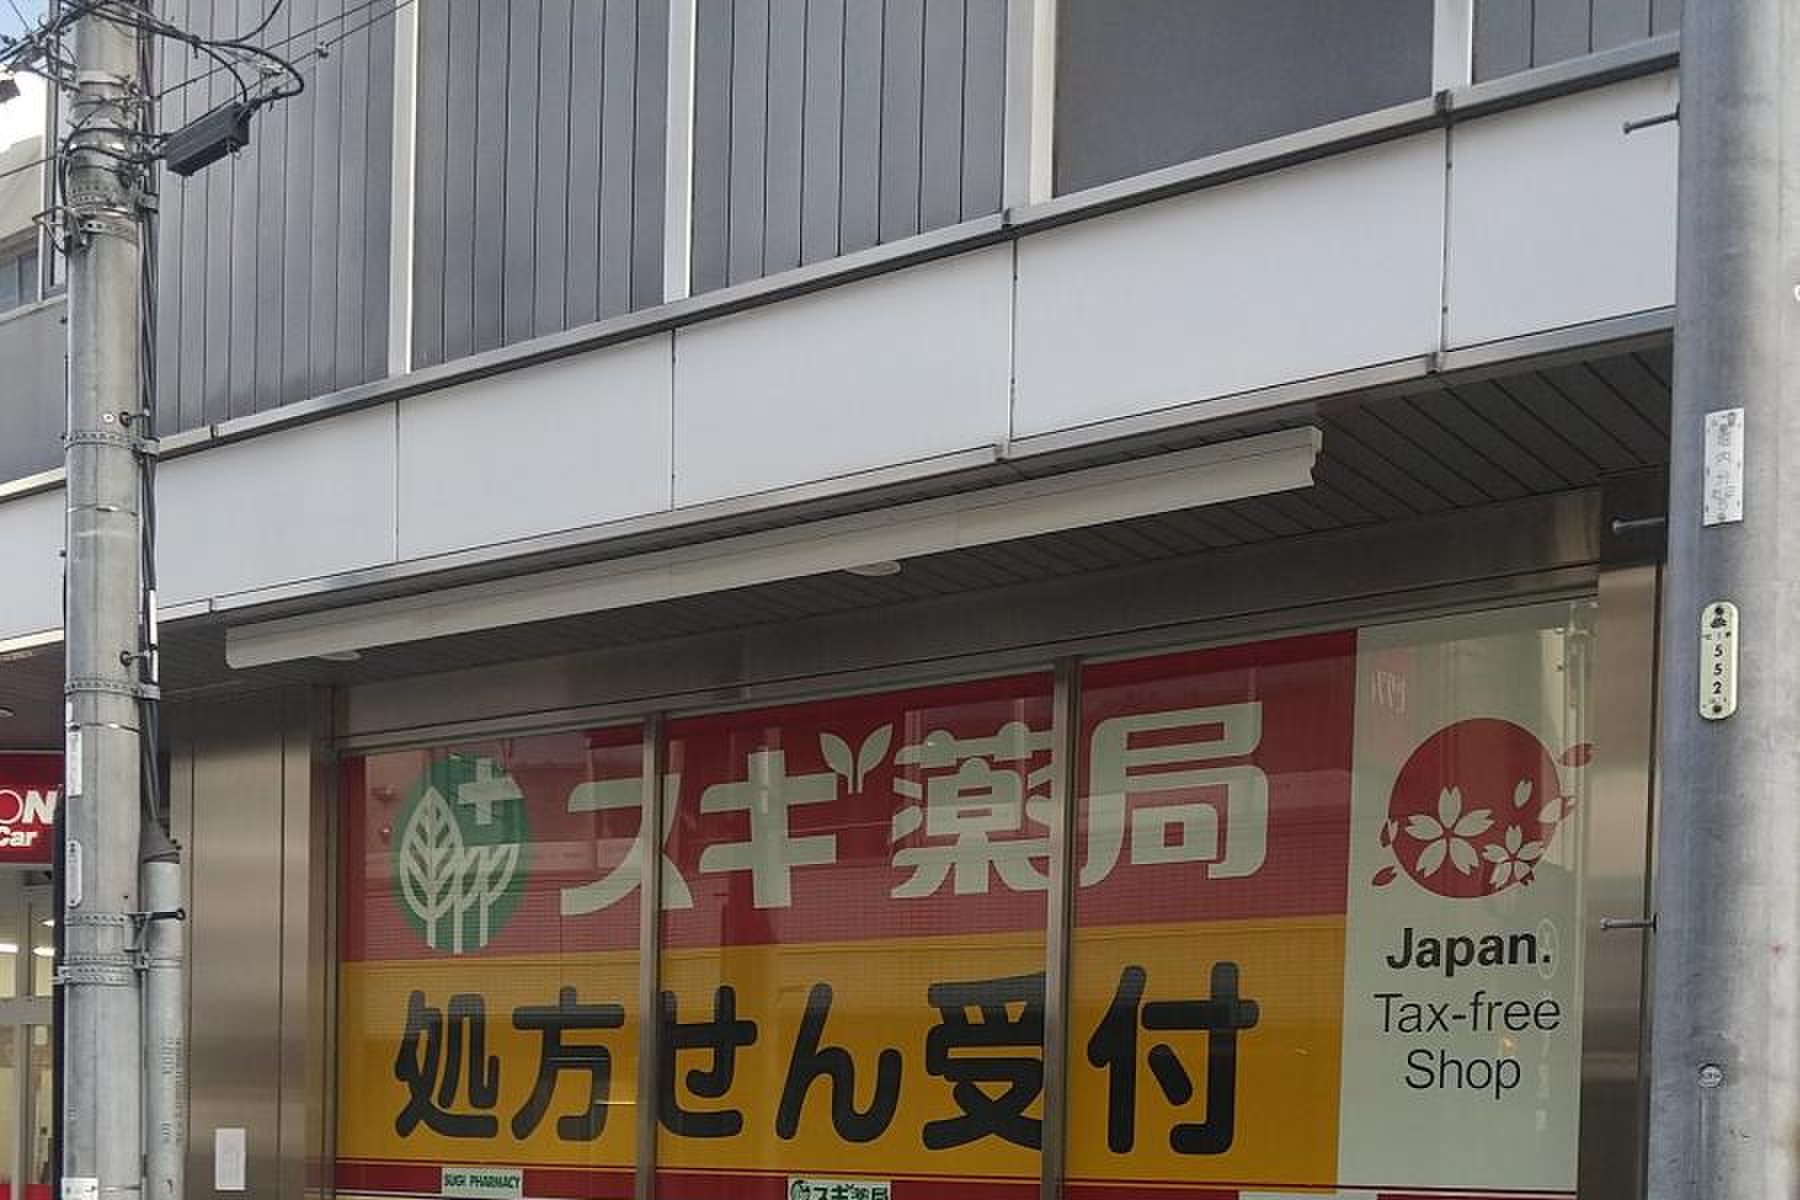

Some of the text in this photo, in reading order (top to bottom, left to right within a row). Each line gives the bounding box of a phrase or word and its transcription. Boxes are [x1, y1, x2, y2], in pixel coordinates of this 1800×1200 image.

[560, 700, 1269, 917] スギ薬局
[1386, 926, 1553, 978] Japan.
[1373, 990, 1562, 1034] Tax-free
[393, 961, 1261, 1155] 処方せん受付
[1404, 1048, 1522, 1100] Shop
[444, 1174, 520, 1188] SUGI PHARMACY
